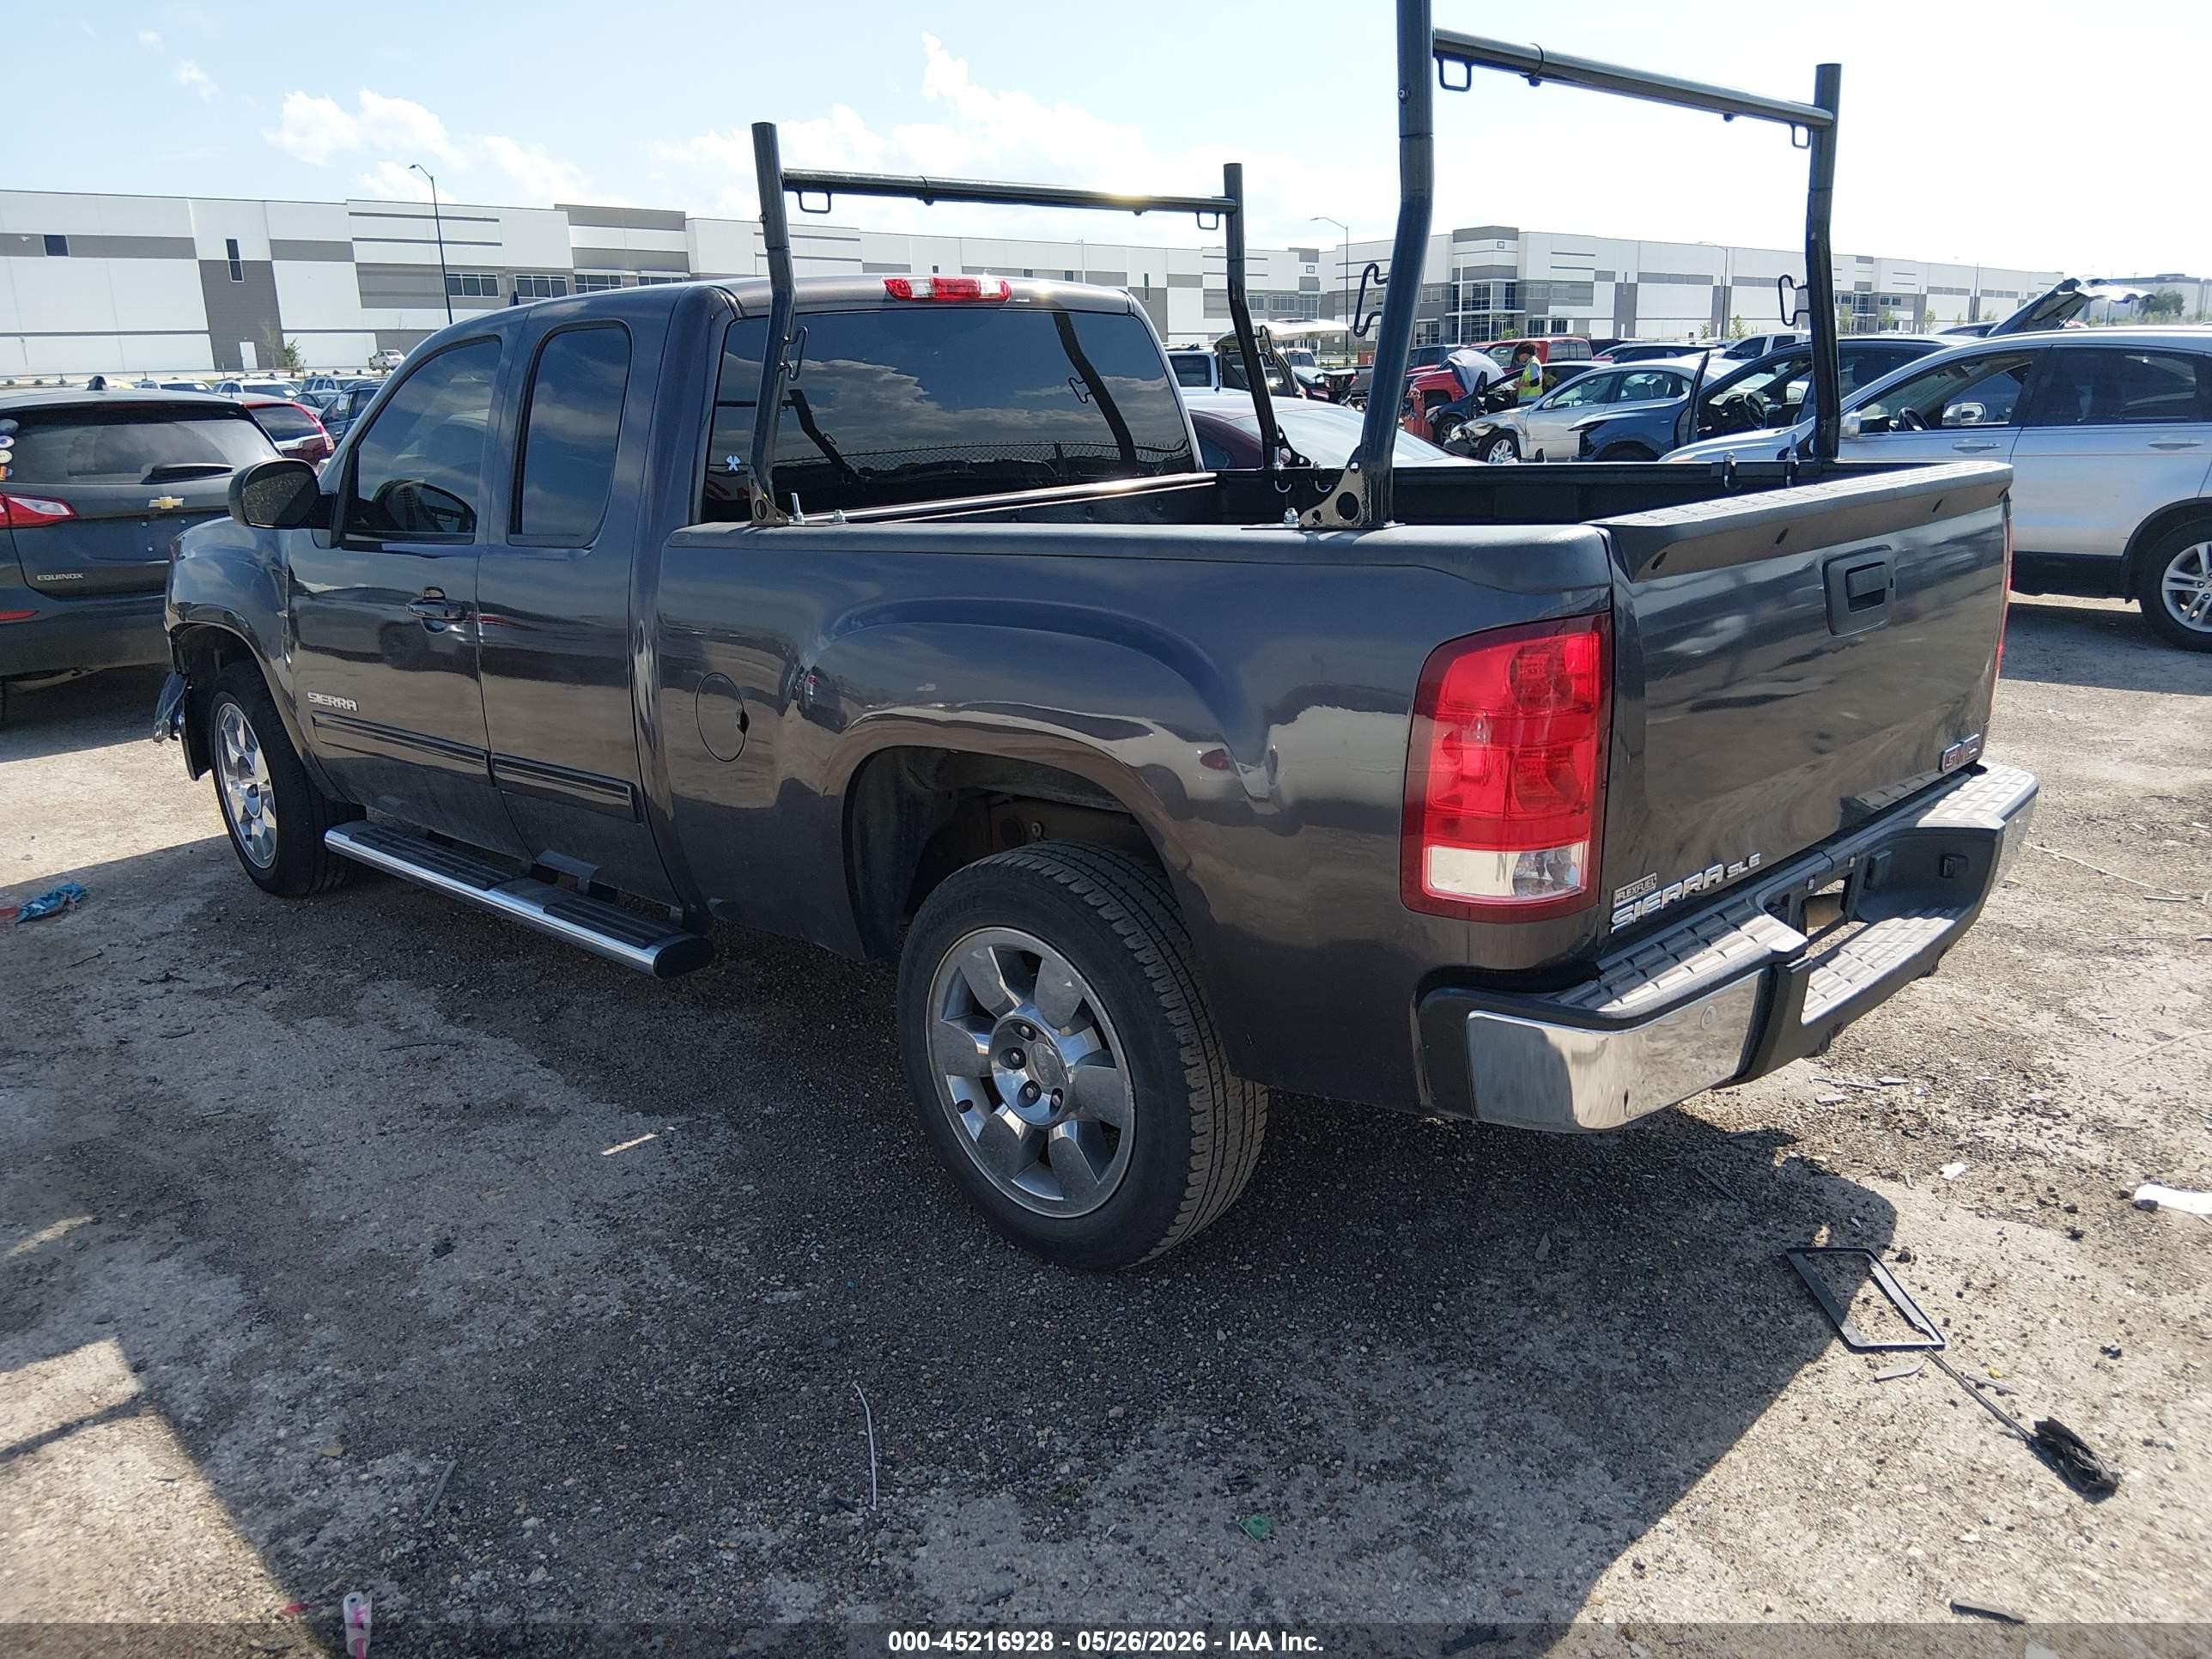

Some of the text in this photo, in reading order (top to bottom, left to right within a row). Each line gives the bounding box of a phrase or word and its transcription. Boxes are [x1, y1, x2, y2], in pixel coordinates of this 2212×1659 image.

[36, 573, 84, 581] EQUINOX
[307, 691, 358, 712] SIERRA
[1610, 853, 1761, 934] SIERRA SLE
